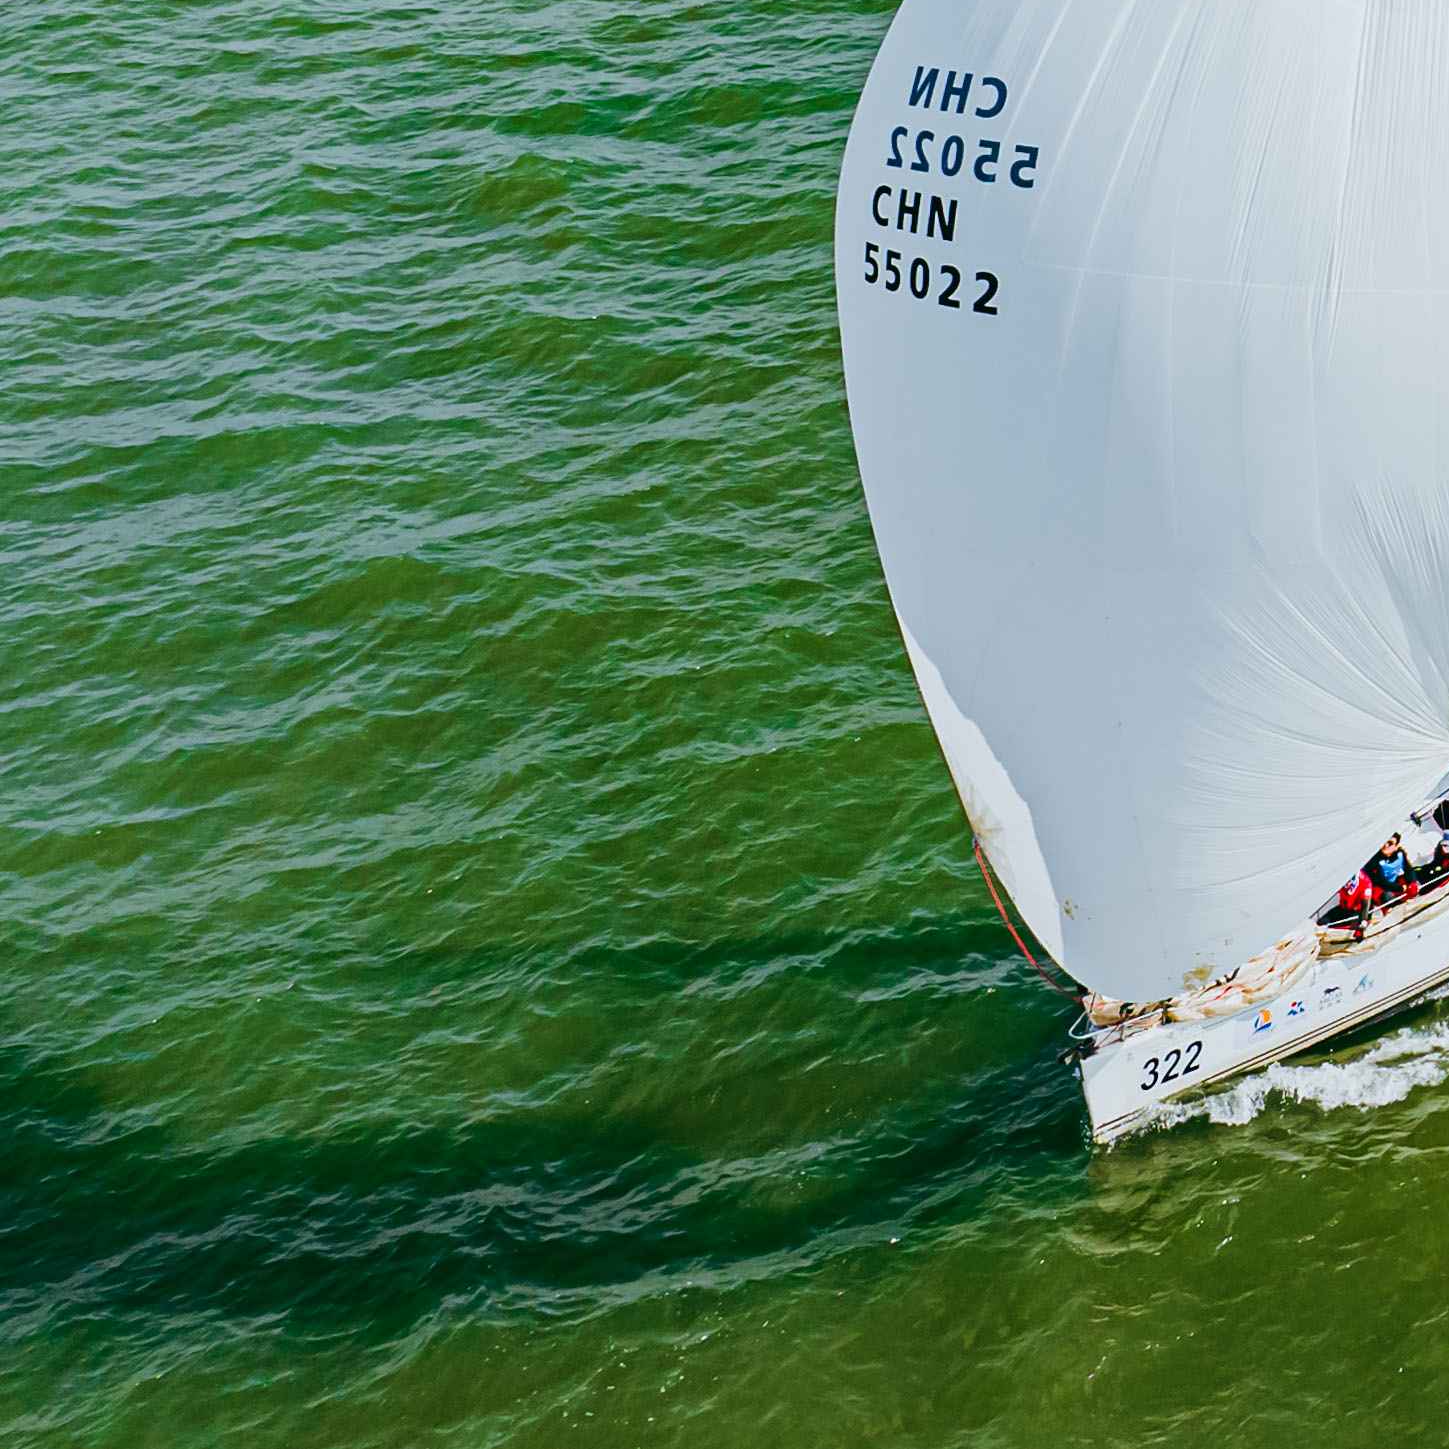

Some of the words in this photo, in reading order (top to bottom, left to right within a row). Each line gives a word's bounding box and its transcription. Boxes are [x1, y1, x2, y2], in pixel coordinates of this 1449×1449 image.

[871, 184, 958, 242] CHN
[864, 241, 999, 316] 55022
[1140, 1040, 1203, 1091] 322
